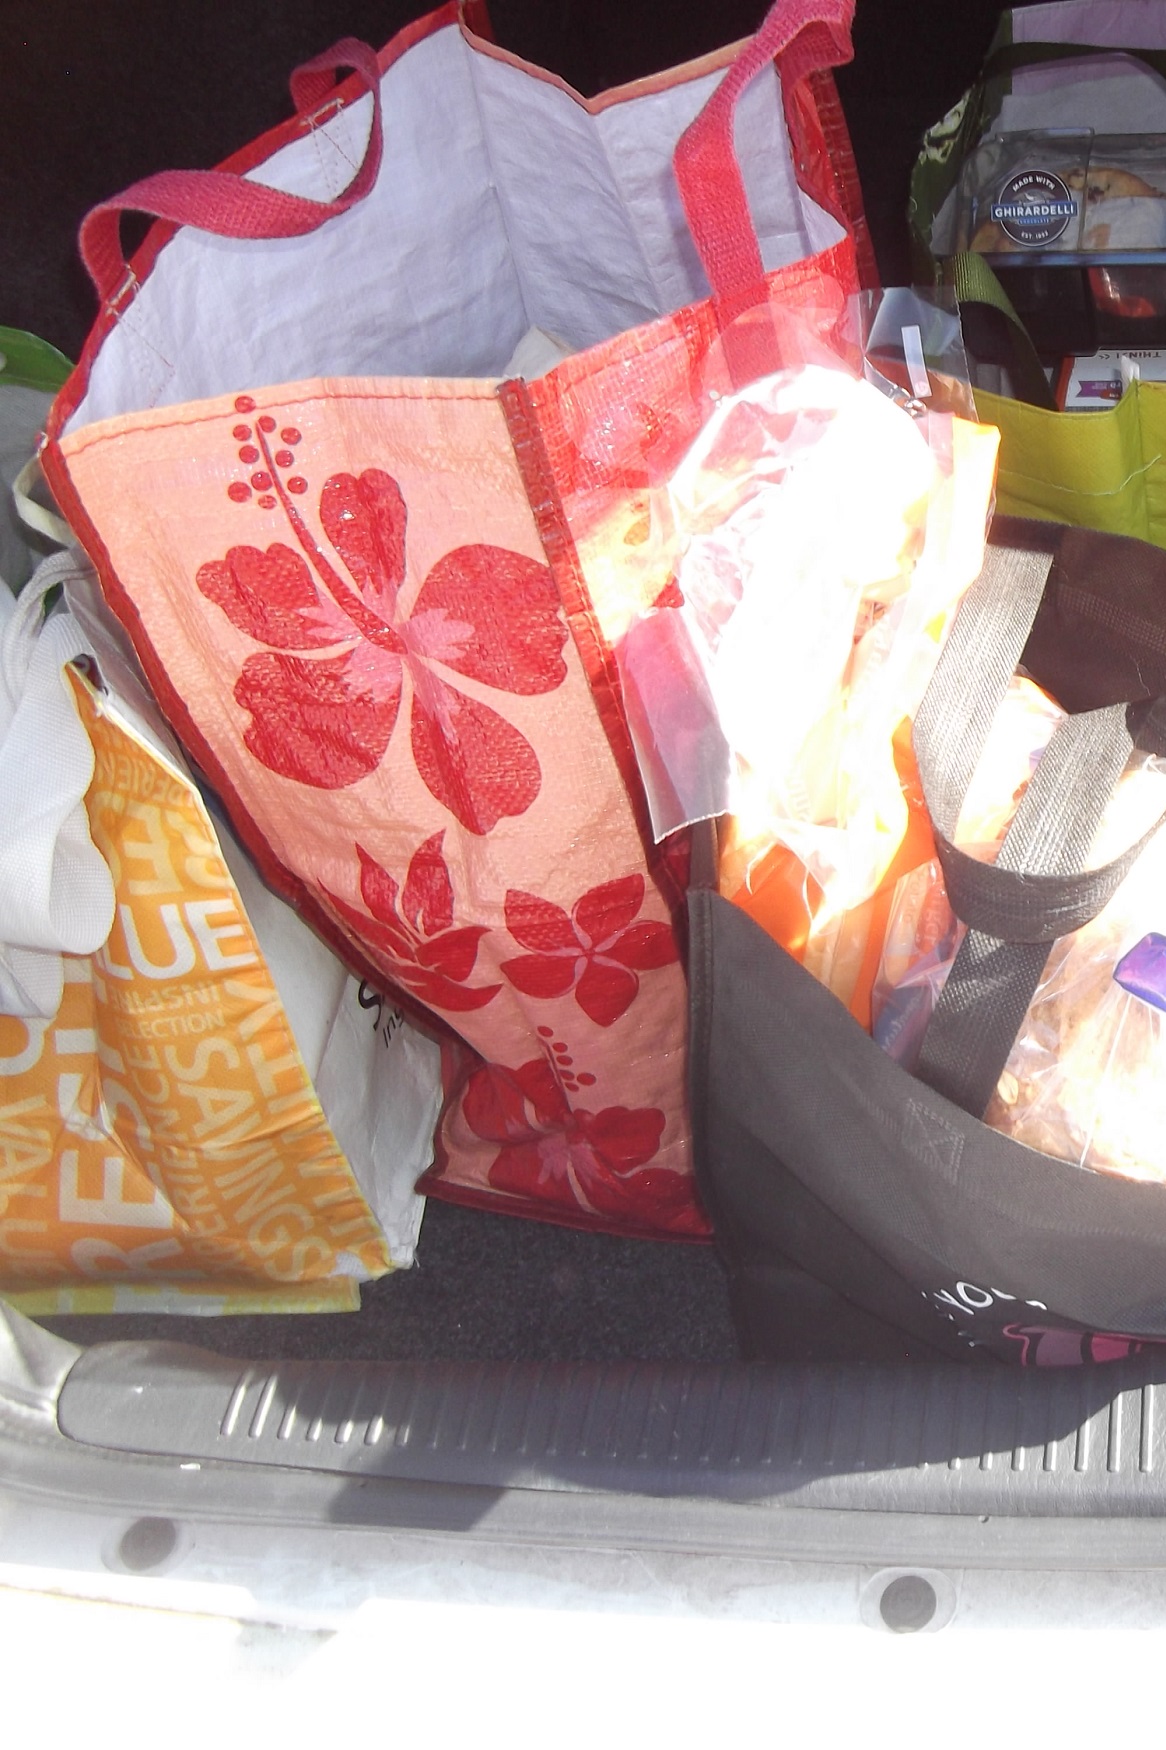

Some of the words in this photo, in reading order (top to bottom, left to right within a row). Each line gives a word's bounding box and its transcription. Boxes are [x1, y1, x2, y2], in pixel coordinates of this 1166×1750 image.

[1012, 175, 1033, 192] MADE
[1035, 175, 1056, 190] WITH
[995, 204, 1074, 217] GHIRARDELLI
[162, 1036, 332, 1281] SAVINGS
